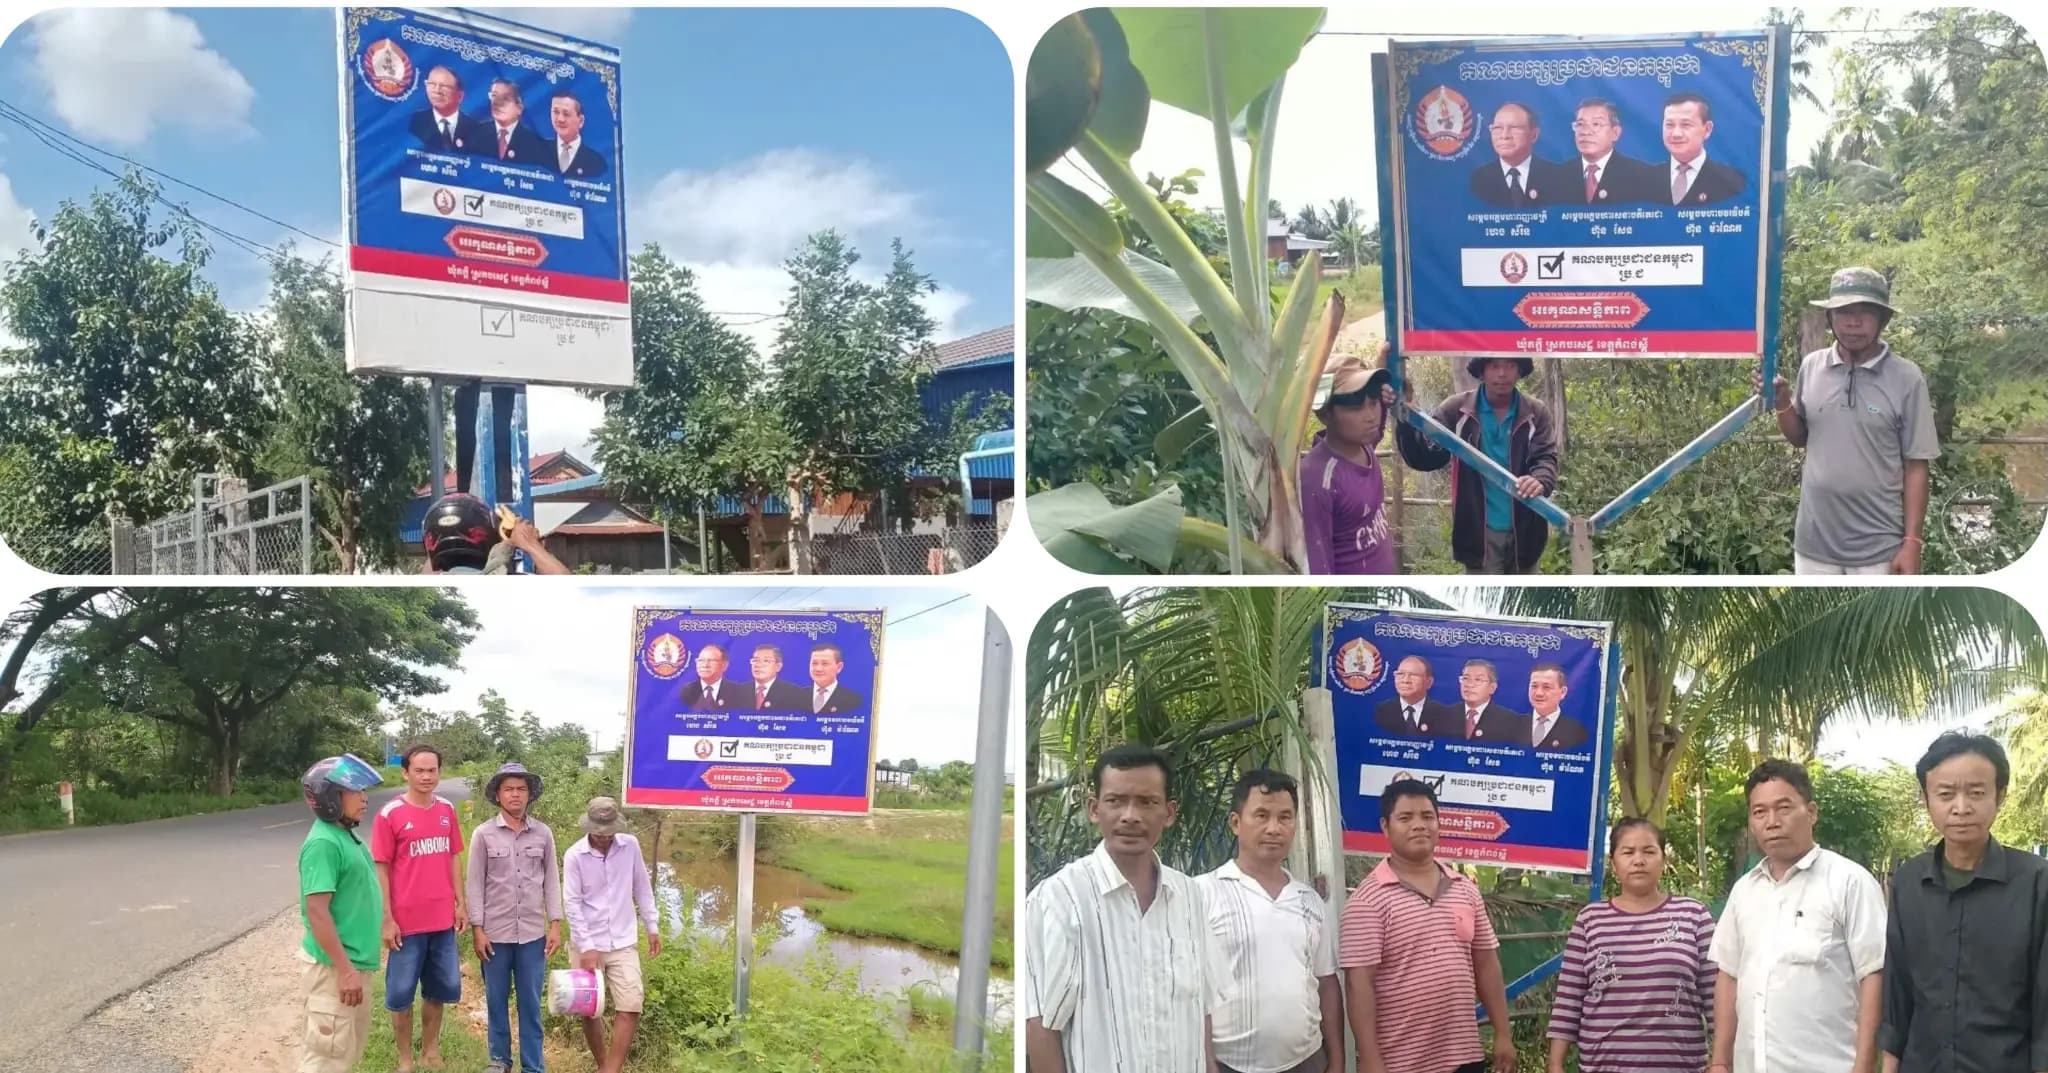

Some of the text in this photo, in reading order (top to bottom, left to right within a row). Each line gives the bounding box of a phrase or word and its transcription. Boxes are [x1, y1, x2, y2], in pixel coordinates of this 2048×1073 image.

[1459, 54, 1700, 88] គណបក្សប្រជាជនកម្ពុជា
[1485, 227, 1505, 237] ហេង
[1591, 223, 1633, 239] ហ៊ុន សែន
[1685, 223, 1702, 238] ហ៊ុន
[1571, 252, 1694, 269] គណបក្សប្រជាជនកម្ពុជា
[1531, 301, 1631, 319] អរគុណសន្តិភាព
[1374, 621, 1561, 658] គណបក្សប្រជាជនកម្ពុជា
[1450, 777, 1546, 796] គណបក្សប្រជាជនកម្ពុជា
[410, 836, 450, 857] CAMBODIA
